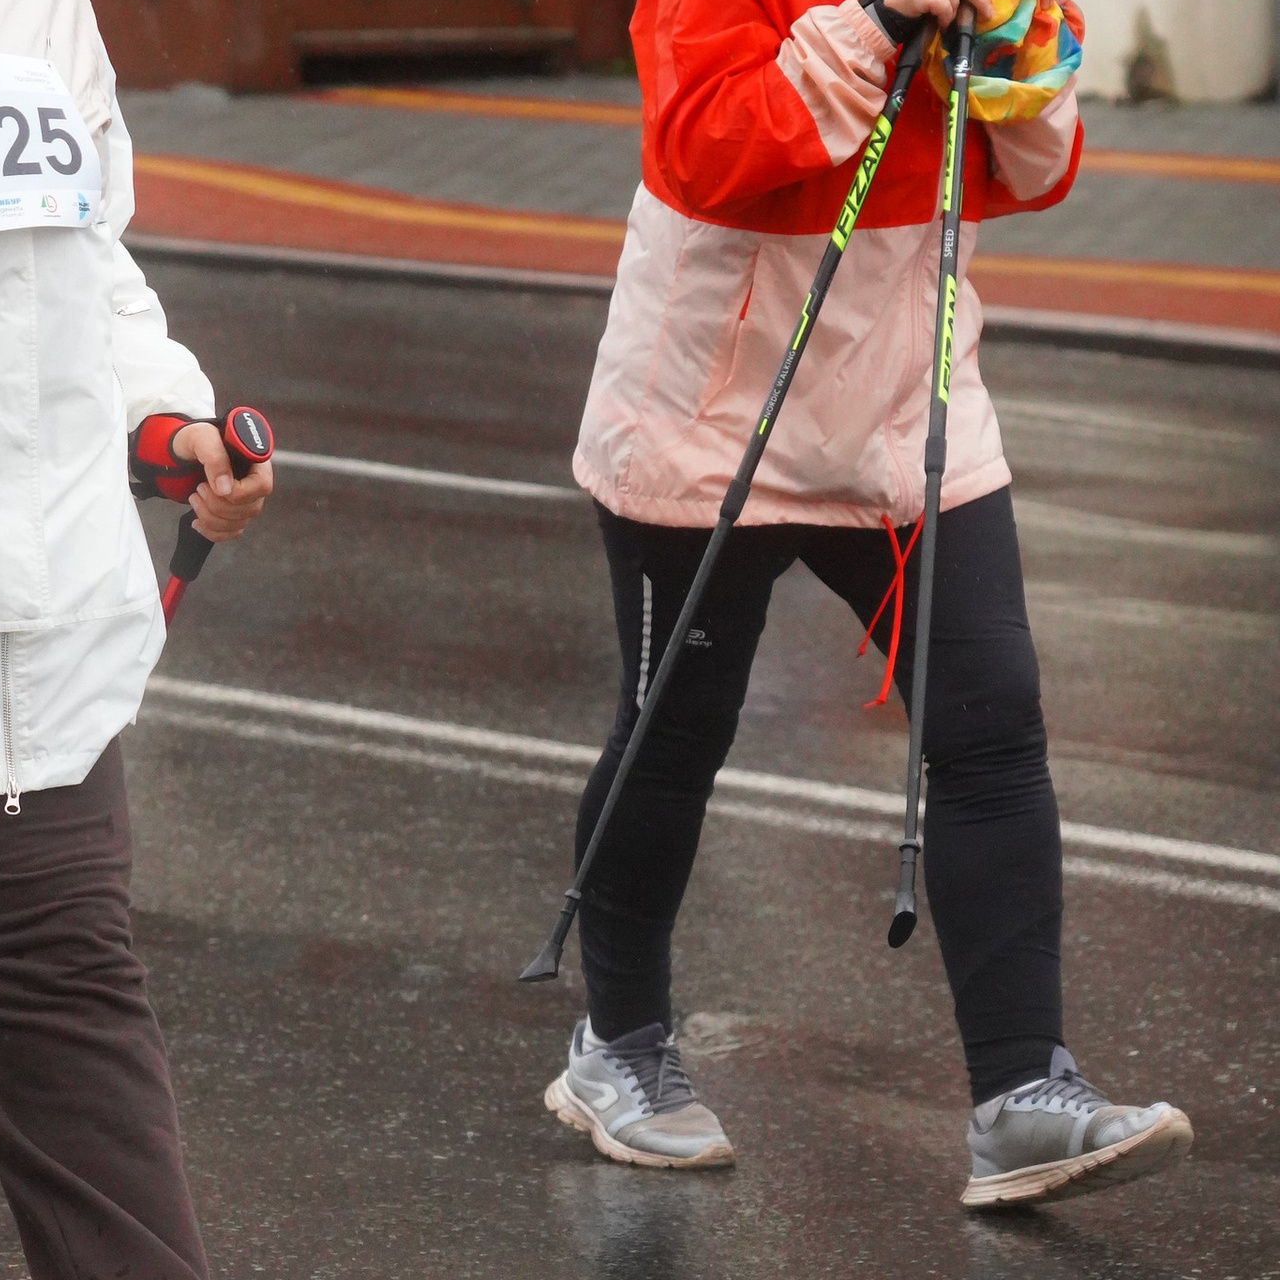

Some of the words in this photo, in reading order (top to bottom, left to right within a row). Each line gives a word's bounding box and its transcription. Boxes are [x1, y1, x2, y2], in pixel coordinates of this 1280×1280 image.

[837, 127, 887, 239] FIZAN
[944, 228, 955, 258] SPEED
[765, 388, 781, 419] NORDIC
[777, 350, 796, 388] WALKING
